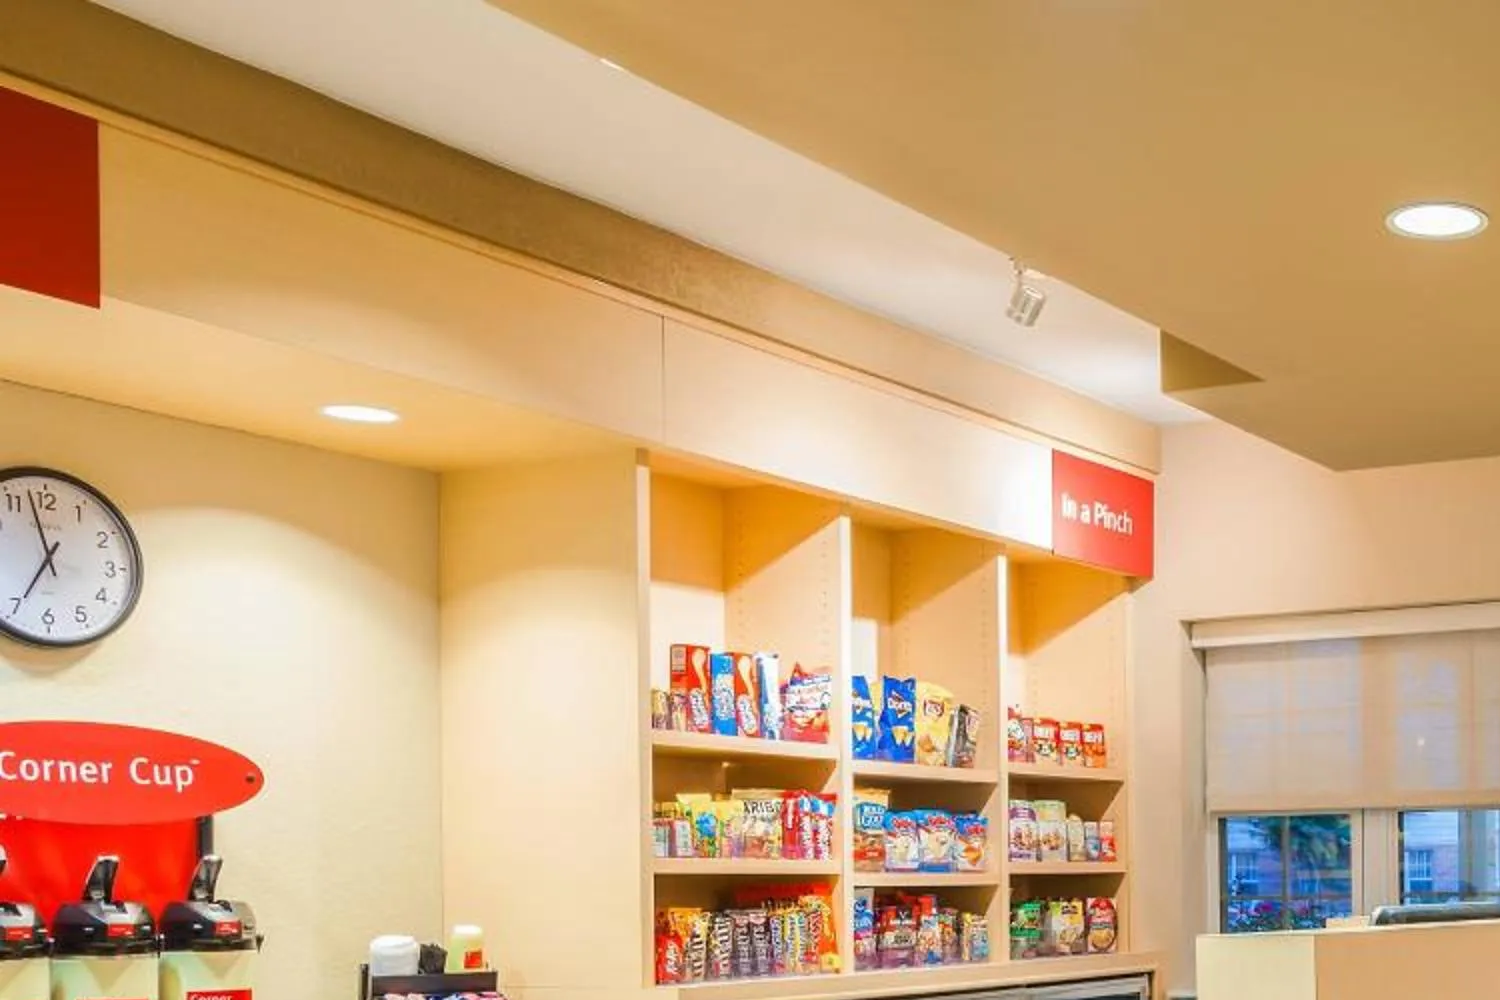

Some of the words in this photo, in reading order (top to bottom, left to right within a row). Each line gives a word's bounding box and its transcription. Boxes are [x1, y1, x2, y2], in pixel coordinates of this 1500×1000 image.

[5, 493, 21, 513] 11
[36, 491, 56, 511] 12
[1061, 492, 1077, 521] In
[1080, 502, 1091, 525] a
[1094, 500, 1133, 536] Pinch
[96, 531, 109, 549] 2
[104, 561, 116, 578] 3
[95, 587, 107, 603] 4
[9, 597, 21, 615] 7
[75, 605, 88, 623] 5
[41, 608, 55, 626] 6
[0, 751, 112, 784] Corner
